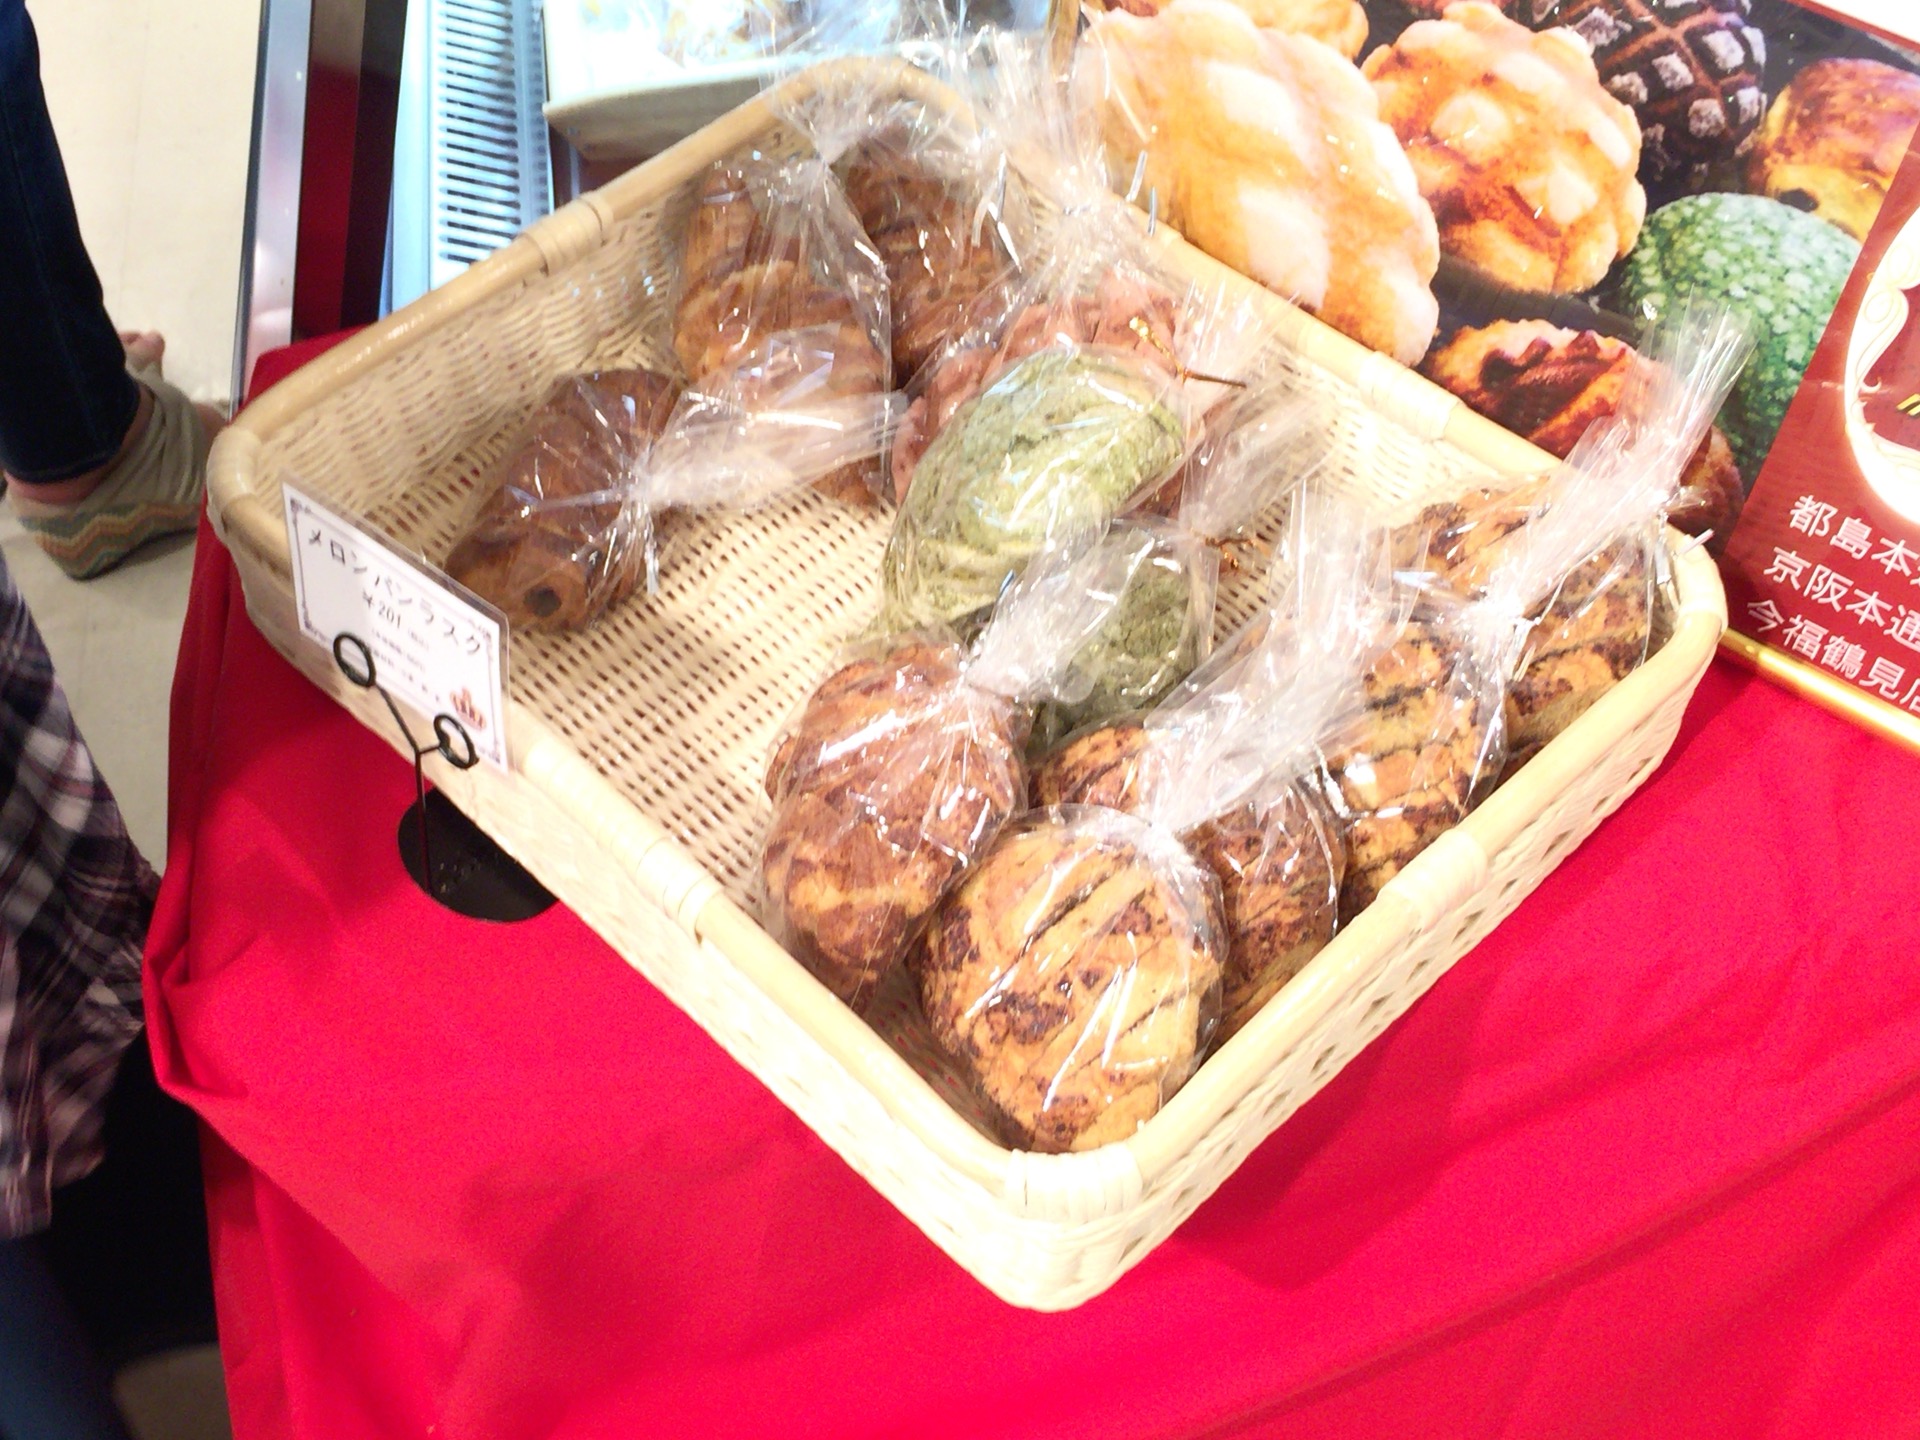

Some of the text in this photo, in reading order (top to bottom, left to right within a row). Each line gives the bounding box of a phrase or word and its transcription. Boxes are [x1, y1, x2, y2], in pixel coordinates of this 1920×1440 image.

[1789, 494, 1920, 586] 都島本
[363, 589, 401, 629] ¥201
